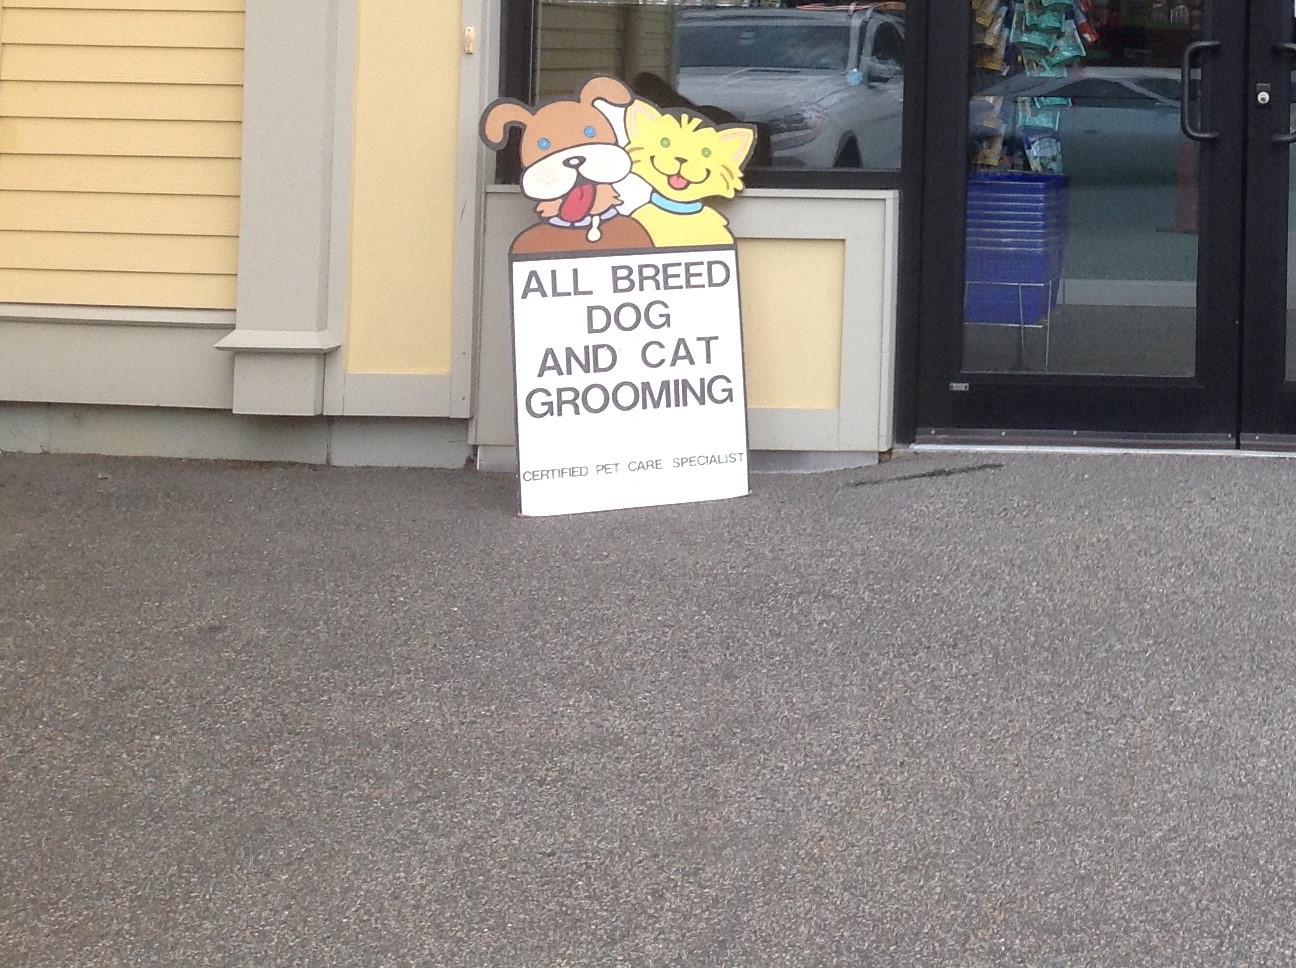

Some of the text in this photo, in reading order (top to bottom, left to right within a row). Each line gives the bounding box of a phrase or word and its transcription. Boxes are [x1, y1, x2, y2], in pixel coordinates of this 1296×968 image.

[520, 259, 731, 300] ALL BREED
[586, 299, 672, 335] DOG
[537, 335, 719, 378] AND CAT
[524, 374, 735, 419] GROOMING
[522, 452, 745, 482] CERTIFIED PET CARE SPECIALIST
